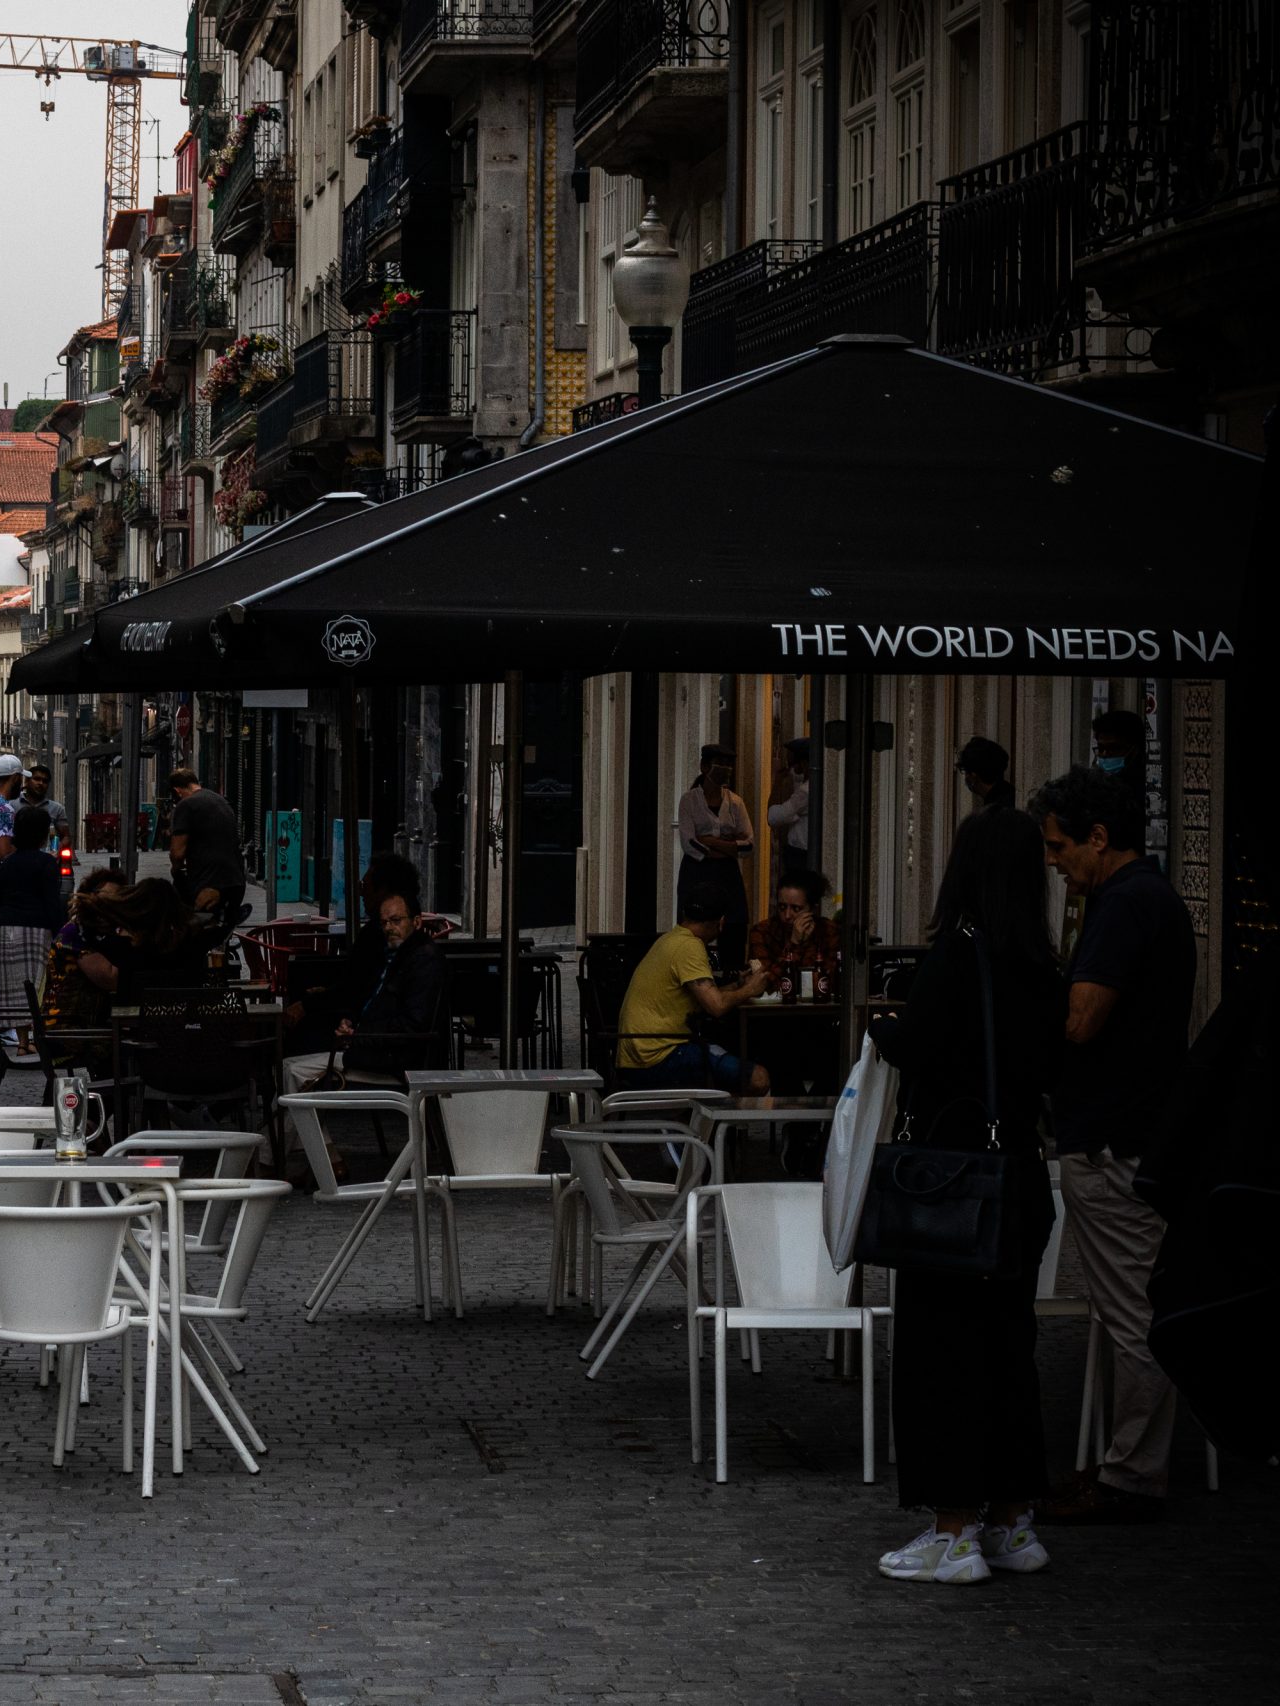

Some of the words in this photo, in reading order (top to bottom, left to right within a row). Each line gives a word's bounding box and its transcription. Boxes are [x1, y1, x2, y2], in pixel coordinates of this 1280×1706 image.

[332, 630, 367, 651] NATA
[771, 624, 848, 656] THE
[857, 625, 1014, 658] WORLD
[1025, 627, 1160, 662] NEEDS
[1172, 629, 1235, 663] NA
